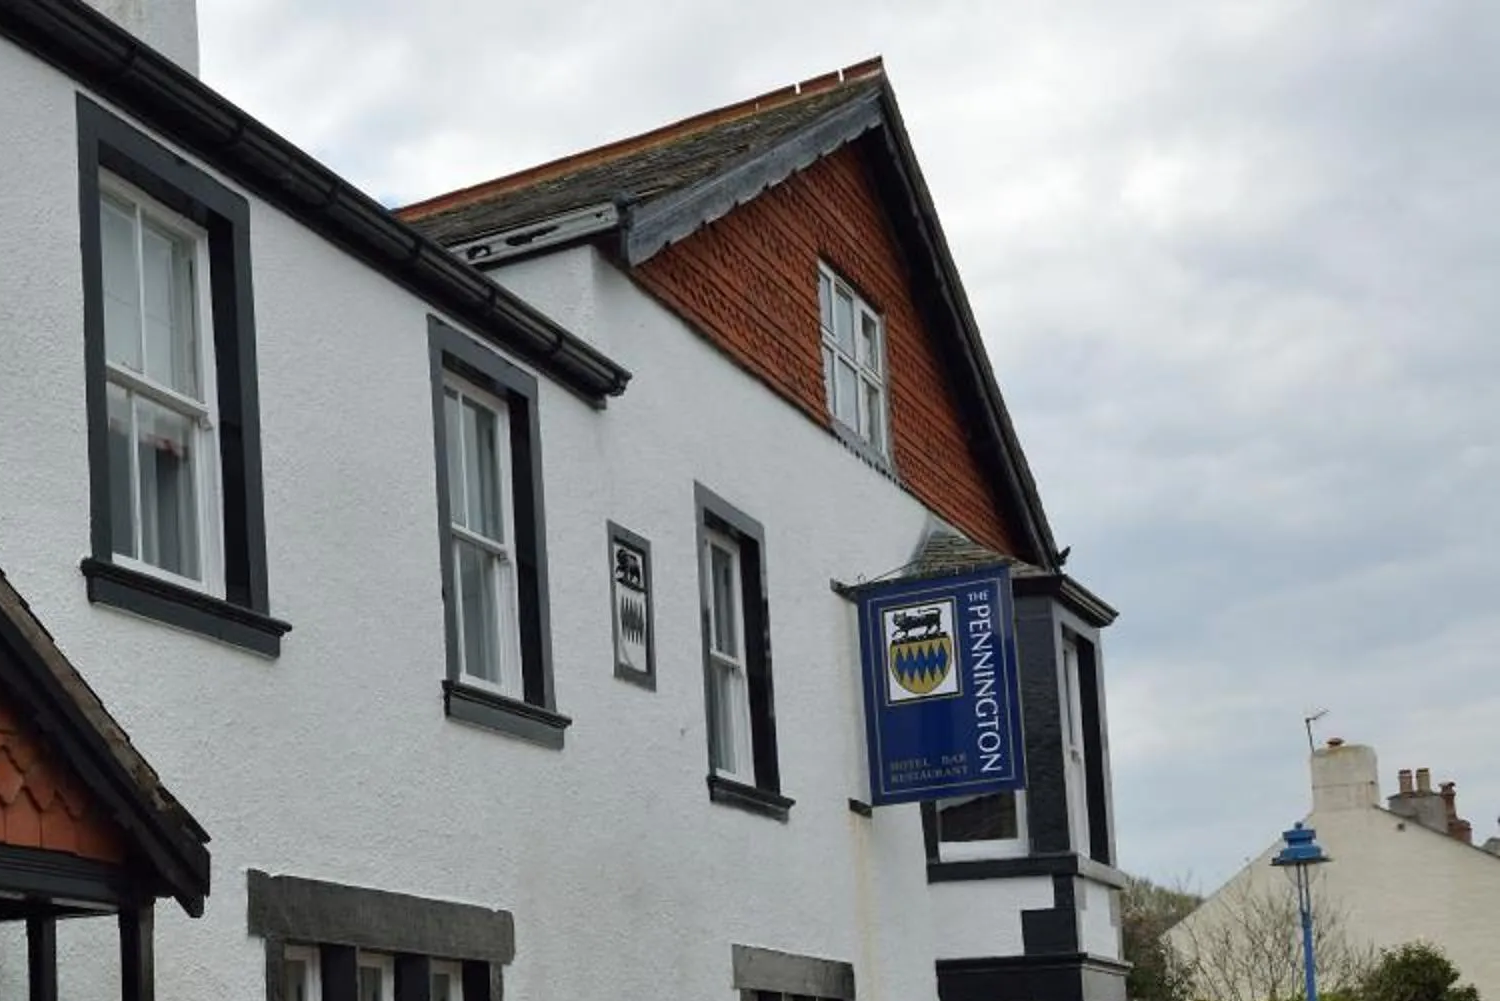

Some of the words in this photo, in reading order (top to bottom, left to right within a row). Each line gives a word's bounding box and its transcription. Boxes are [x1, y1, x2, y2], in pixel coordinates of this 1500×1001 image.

[967, 589, 989, 602] THE
[968, 605, 1003, 773] PENNINGTON
[890, 756, 930, 771] HOTEL
[890, 765, 968, 783] RESTAURANT
